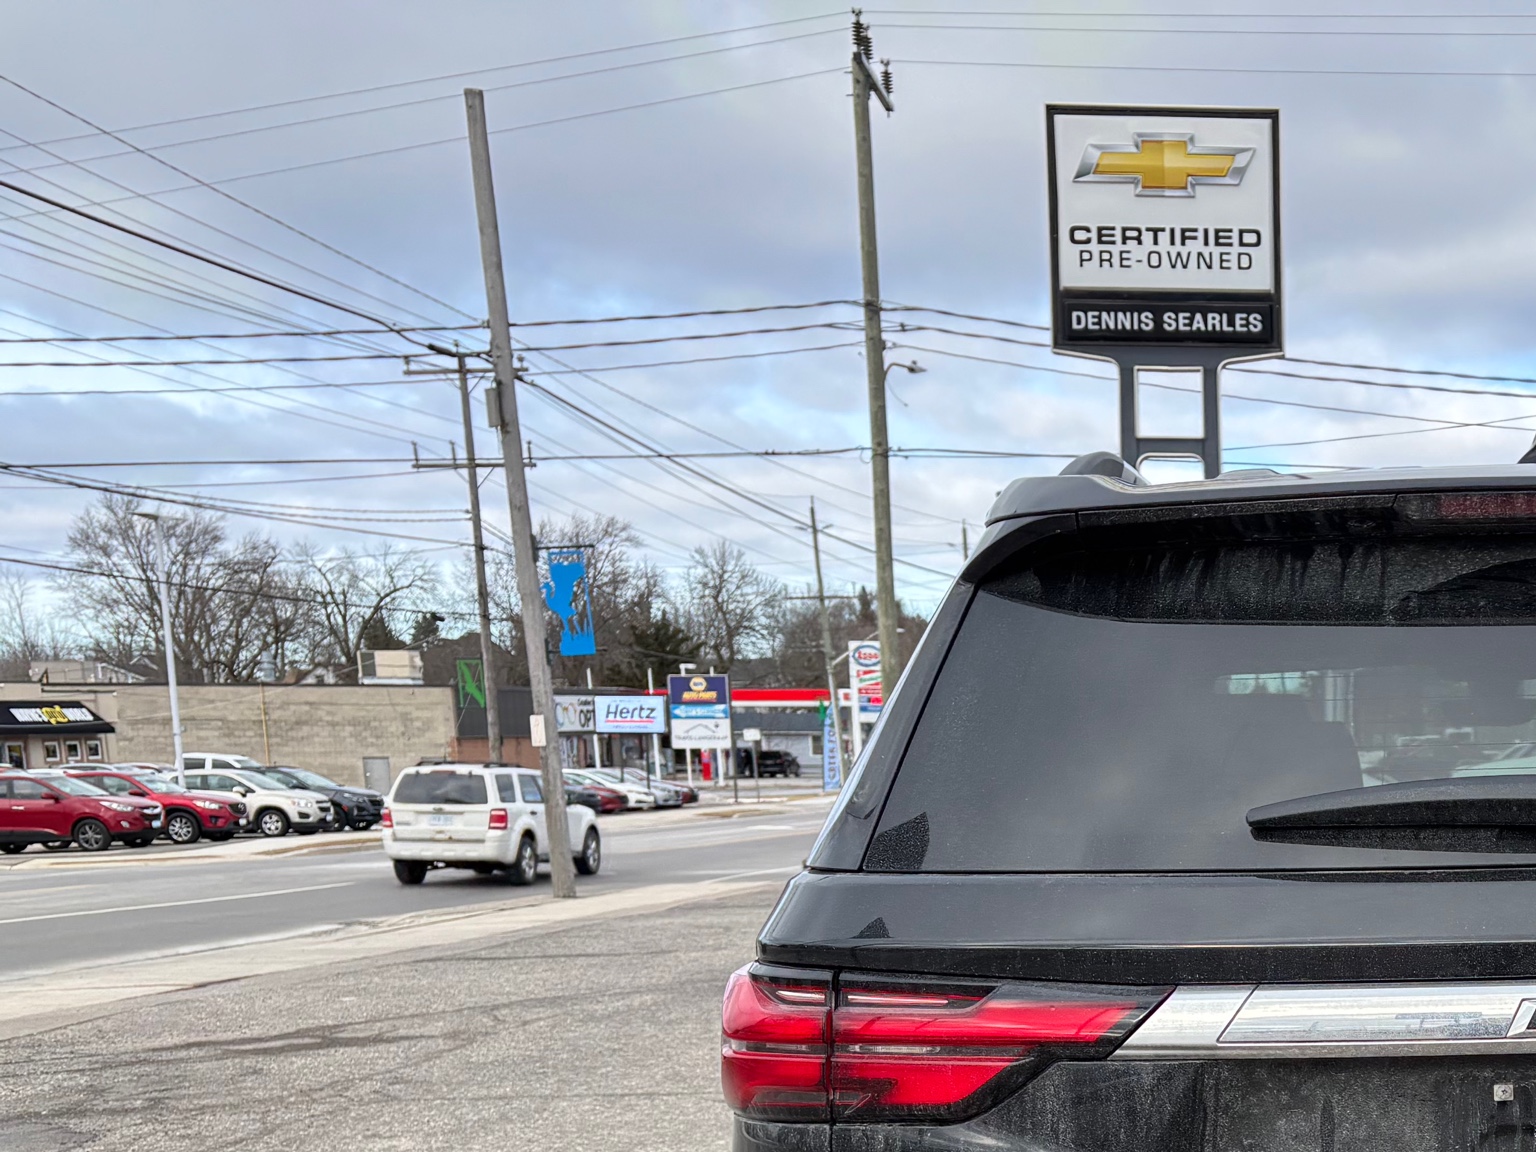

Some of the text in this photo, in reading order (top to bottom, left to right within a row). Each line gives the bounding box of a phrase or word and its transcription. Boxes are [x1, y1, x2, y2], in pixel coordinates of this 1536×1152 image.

[1069, 225, 1262, 248] CERTIFIED
[1079, 250, 1253, 271] PRE-OWNED
[1071, 310, 1263, 333] DENNIS SEARLES
[605, 703, 657, 719] Hertz
